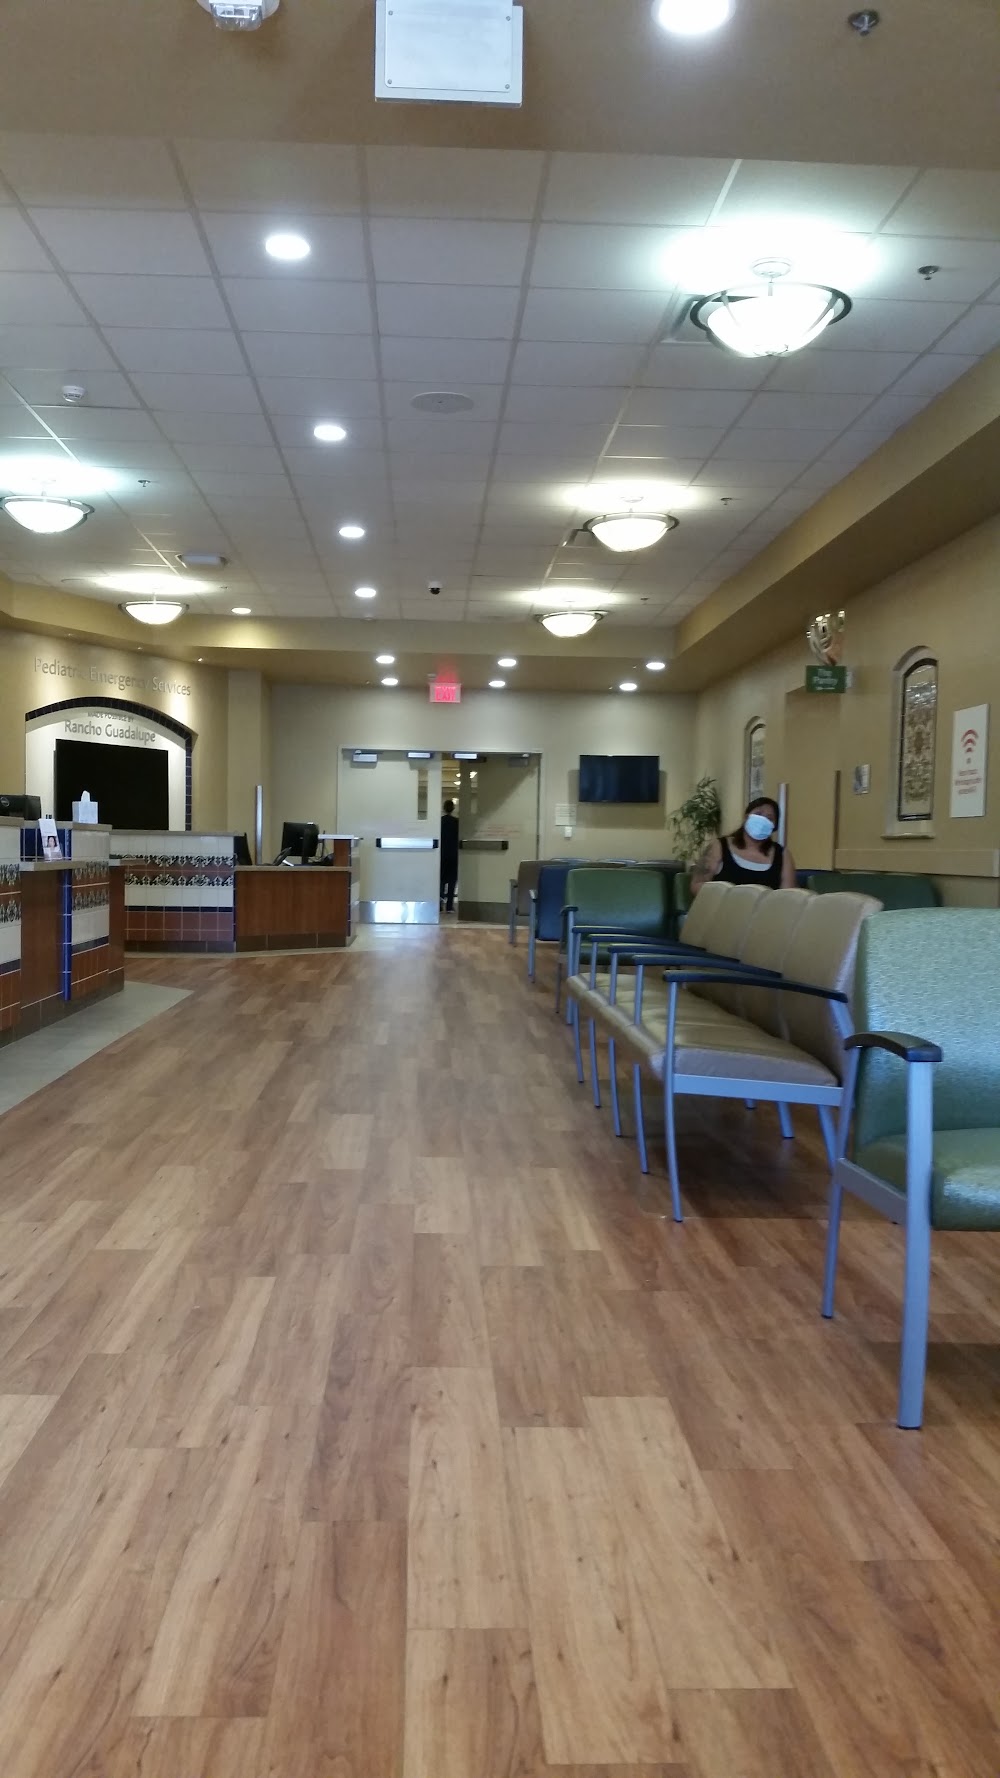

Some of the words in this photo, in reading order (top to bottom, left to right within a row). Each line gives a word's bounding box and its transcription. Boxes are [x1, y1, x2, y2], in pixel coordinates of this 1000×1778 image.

[34, 656, 86, 680] Pediatric
[89, 667, 149, 690] Emergency
[152, 677, 191, 696] Services
[64, 719, 102, 736] Rancho
[105, 724, 156, 747] Guadalupe
